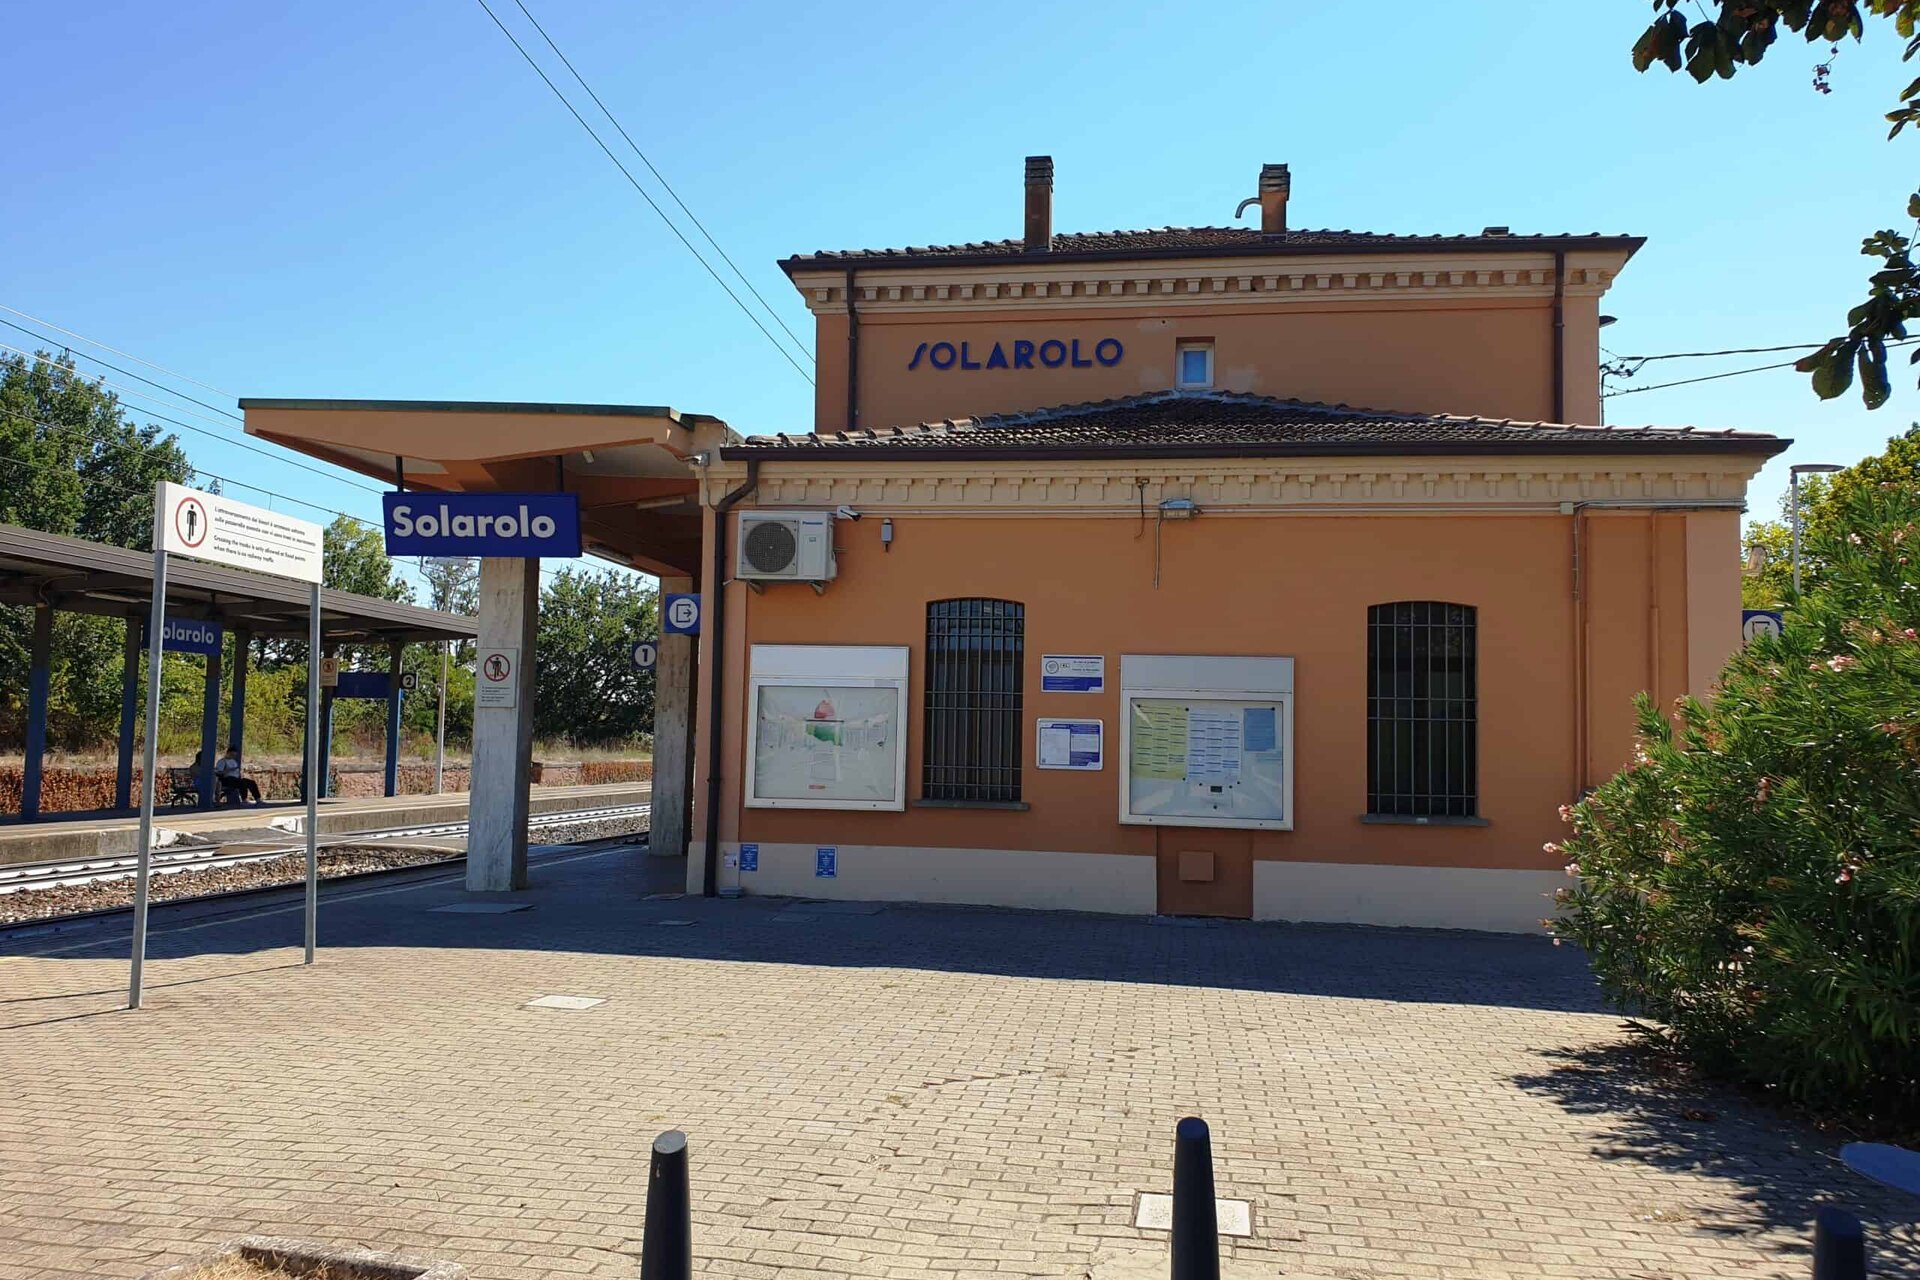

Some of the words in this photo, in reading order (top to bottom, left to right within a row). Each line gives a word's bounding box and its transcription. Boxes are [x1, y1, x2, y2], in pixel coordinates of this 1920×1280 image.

[908, 337, 1124, 371] SOLAROLO
[392, 504, 556, 539] Solarolo
[163, 621, 214, 645] olarolo
[642, 648, 649, 662] 1
[405, 676, 413, 686] 2
